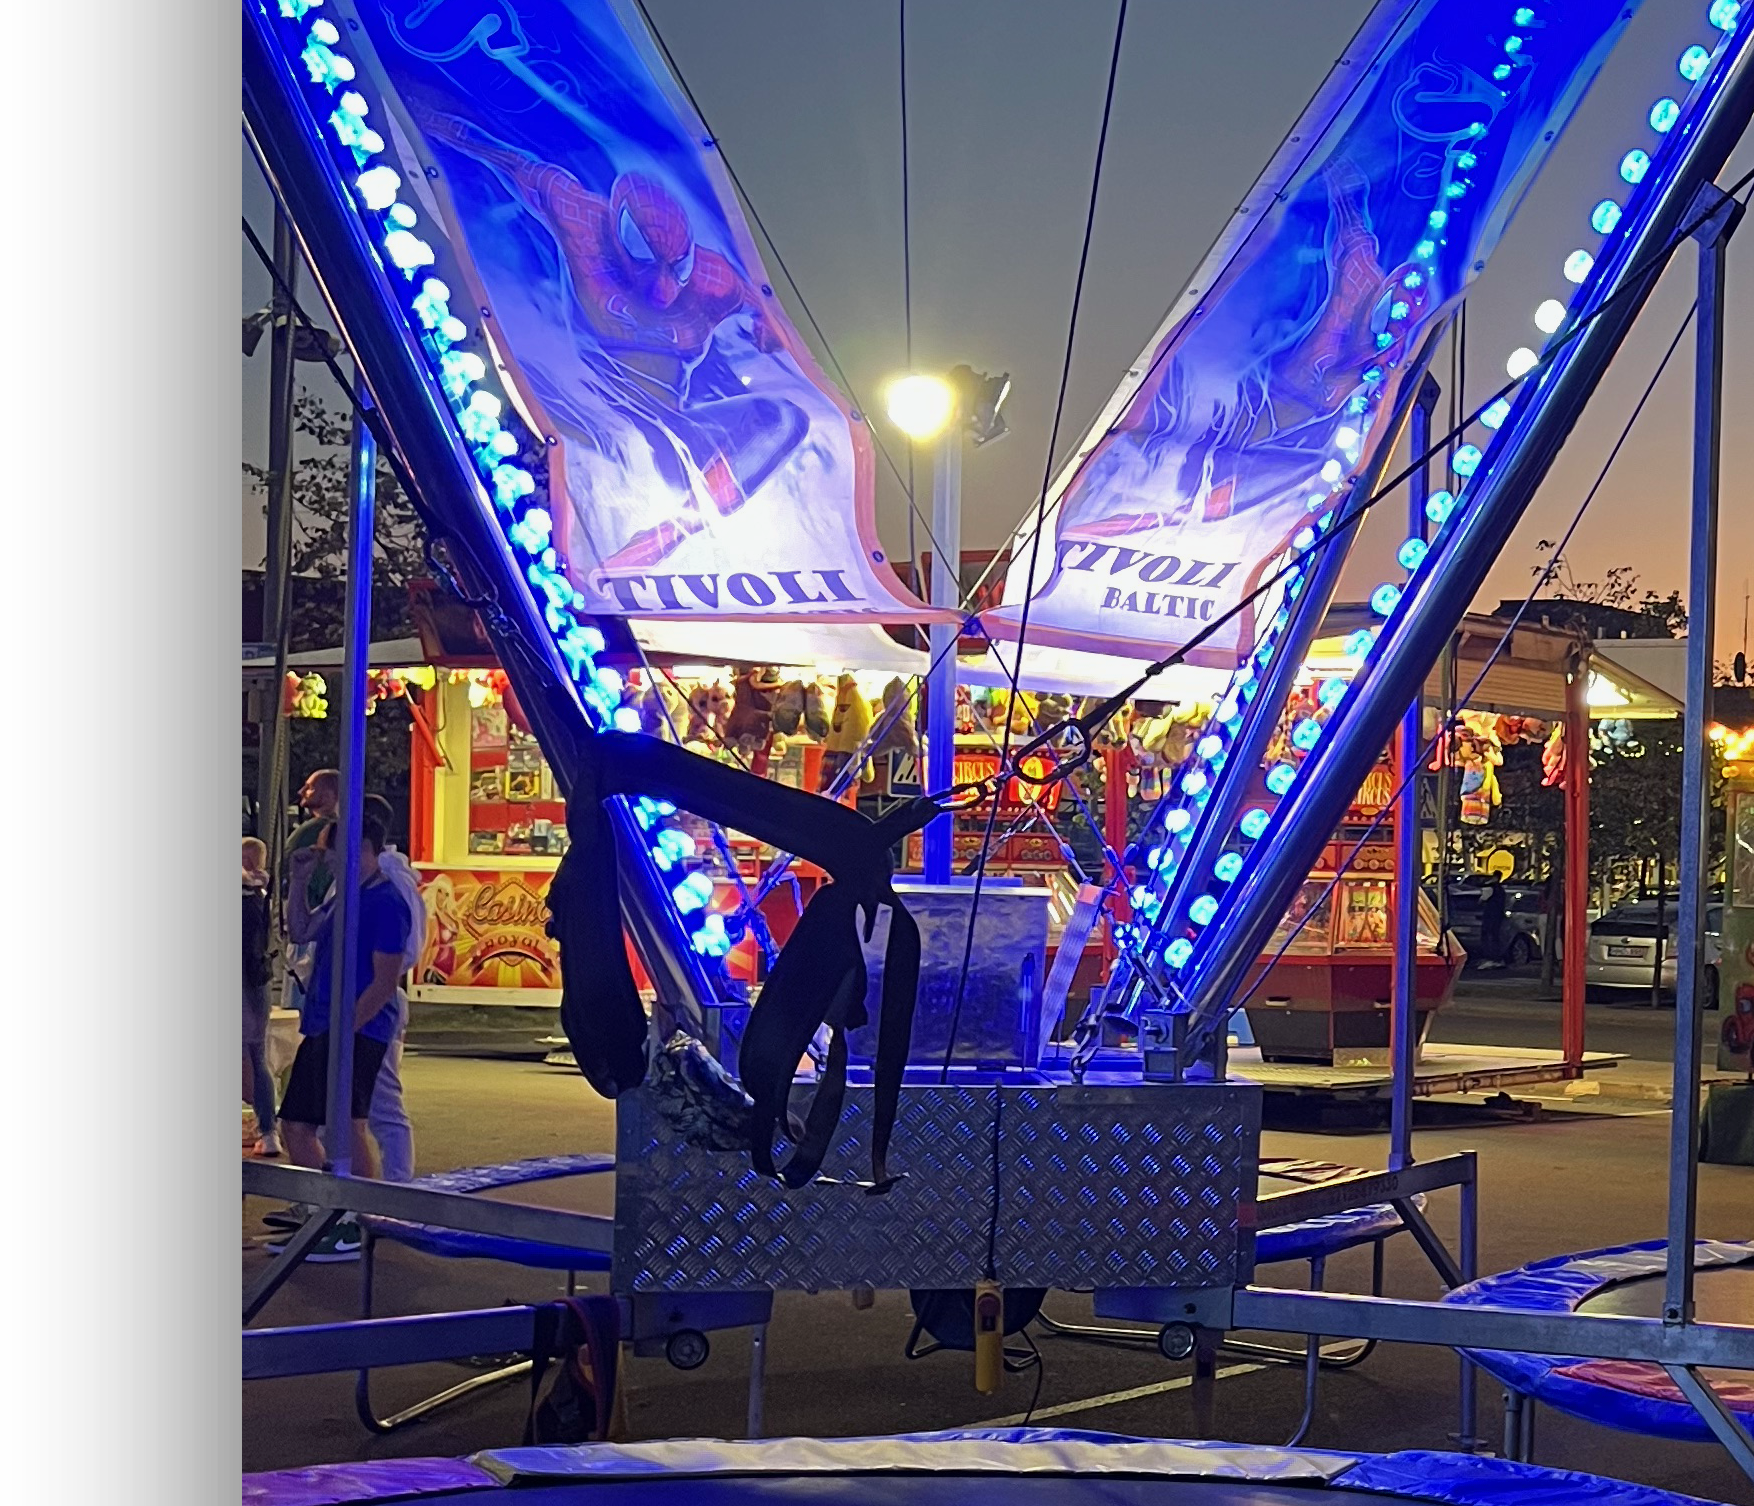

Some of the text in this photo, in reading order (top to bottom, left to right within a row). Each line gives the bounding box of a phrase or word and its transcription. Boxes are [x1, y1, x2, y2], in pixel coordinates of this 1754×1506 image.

[1059, 539, 1242, 589] TIVOLI
[596, 569, 866, 612] TIVOLI
[1099, 586, 1216, 622] BALTIC
